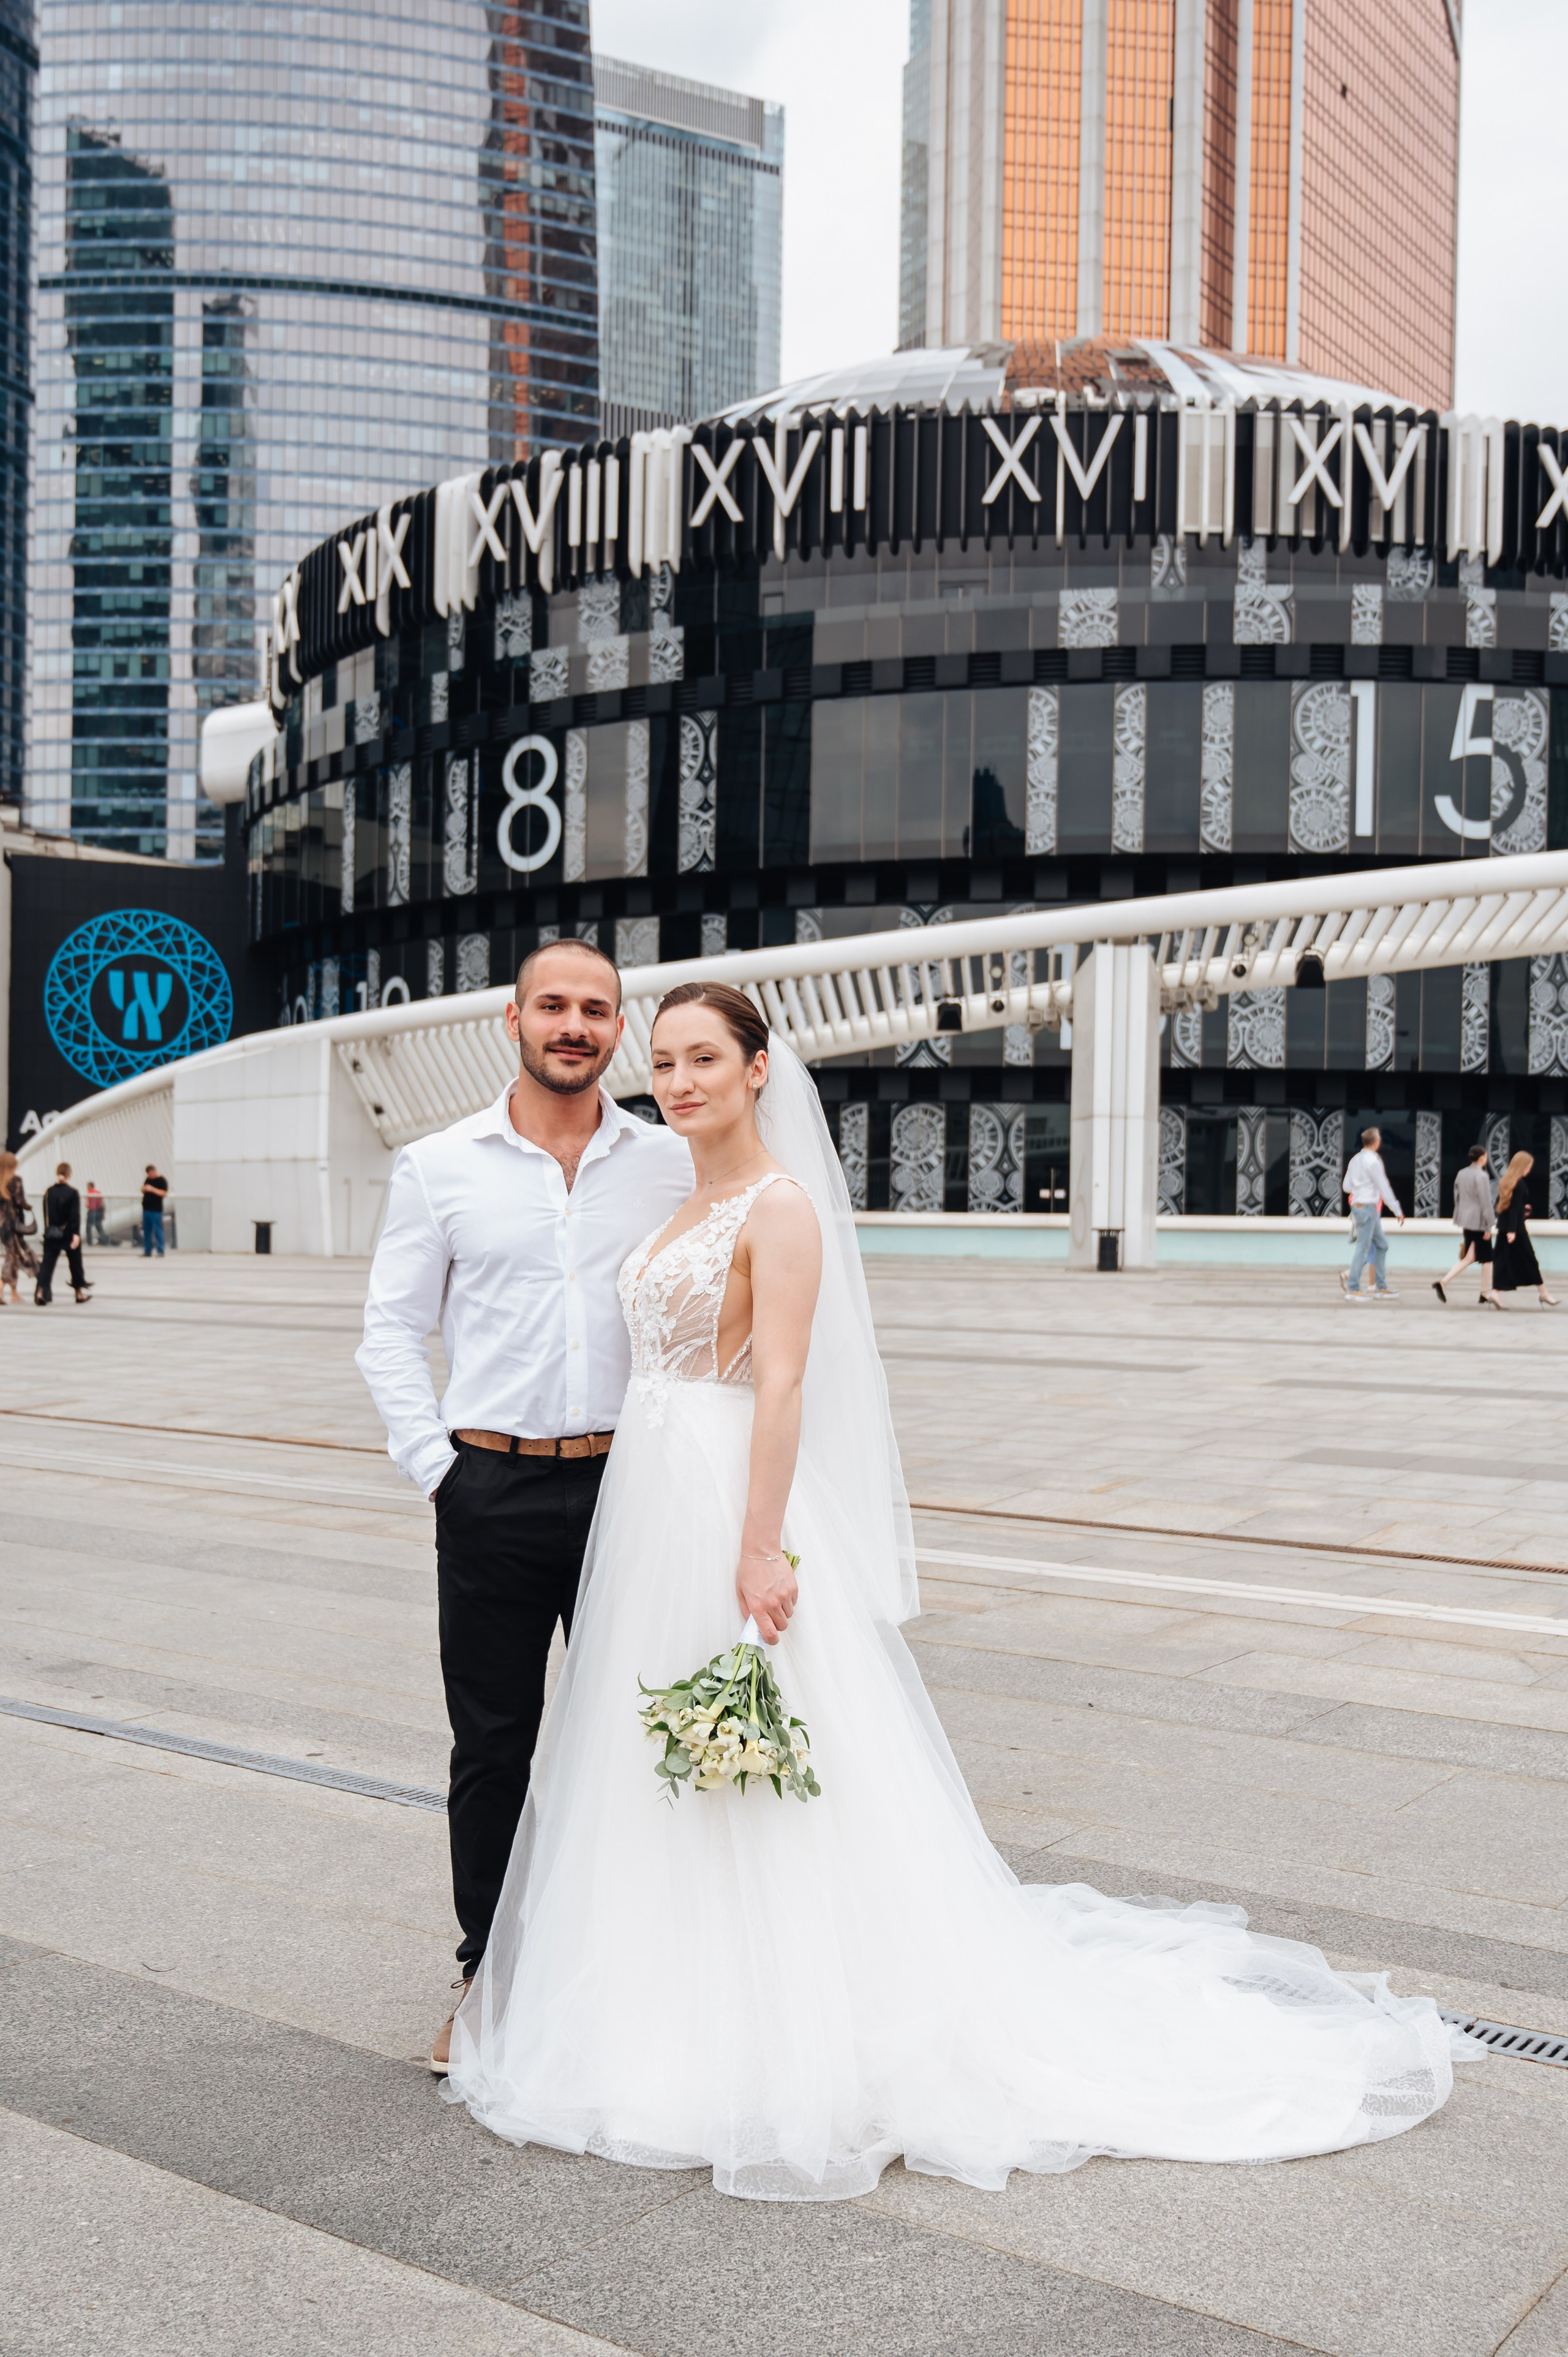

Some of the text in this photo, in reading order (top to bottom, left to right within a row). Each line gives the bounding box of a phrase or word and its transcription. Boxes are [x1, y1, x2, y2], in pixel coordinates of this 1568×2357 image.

[337, 513, 412, 614] XIX
[468, 454, 619, 567] XVIII
[688, 426, 867, 527] XVII
[981, 414, 1148, 504] XVI
[1287, 419, 1423, 511] XV
[497, 734, 562, 872] 8
[1350, 680, 1527, 839] 15
